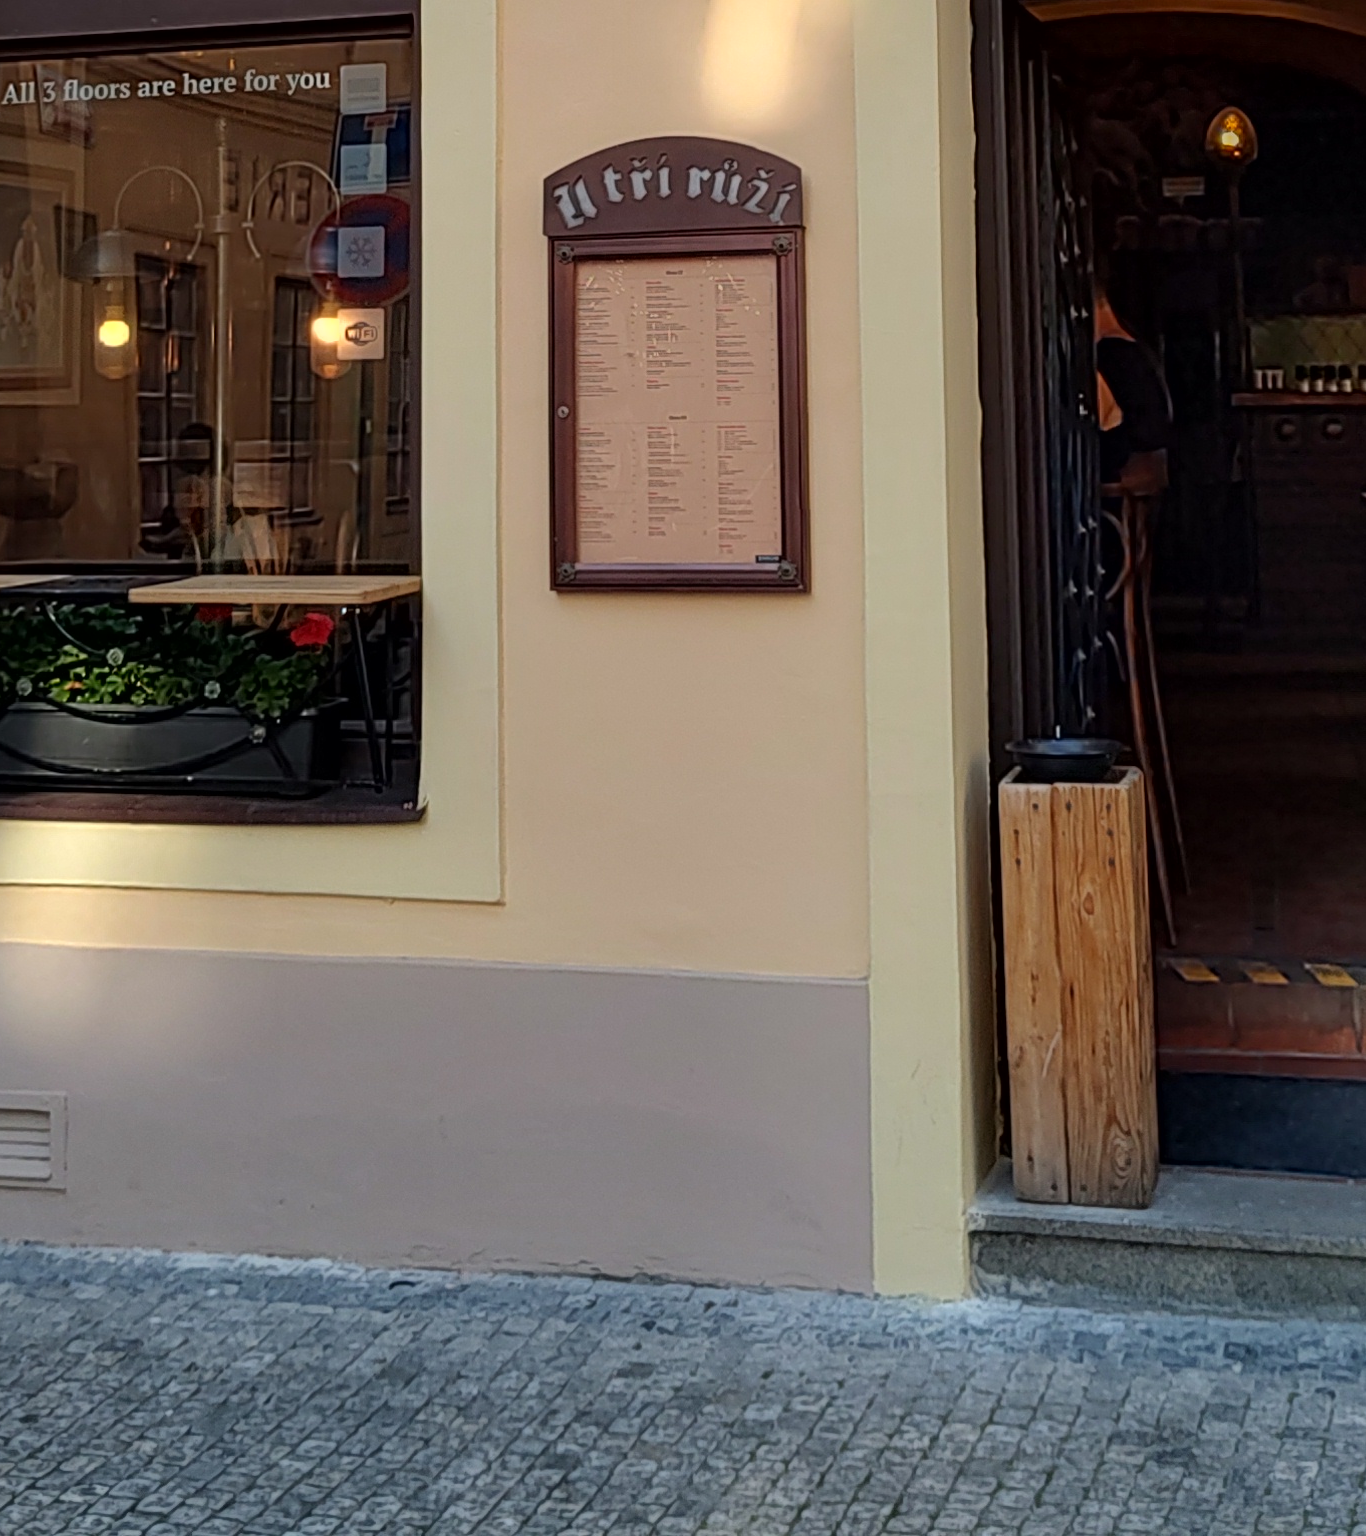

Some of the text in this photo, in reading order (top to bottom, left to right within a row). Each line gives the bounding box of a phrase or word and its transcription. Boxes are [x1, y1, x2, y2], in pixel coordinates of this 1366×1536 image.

[1, 81, 35, 106] All
[43, 80, 57, 104] 3
[63, 75, 132, 103] floors
[137, 78, 176, 98] are
[182, 72, 238, 96] here
[243, 69, 281, 94] for
[286, 69, 332, 96] you
[552, 153, 797, 230] U tří růží
